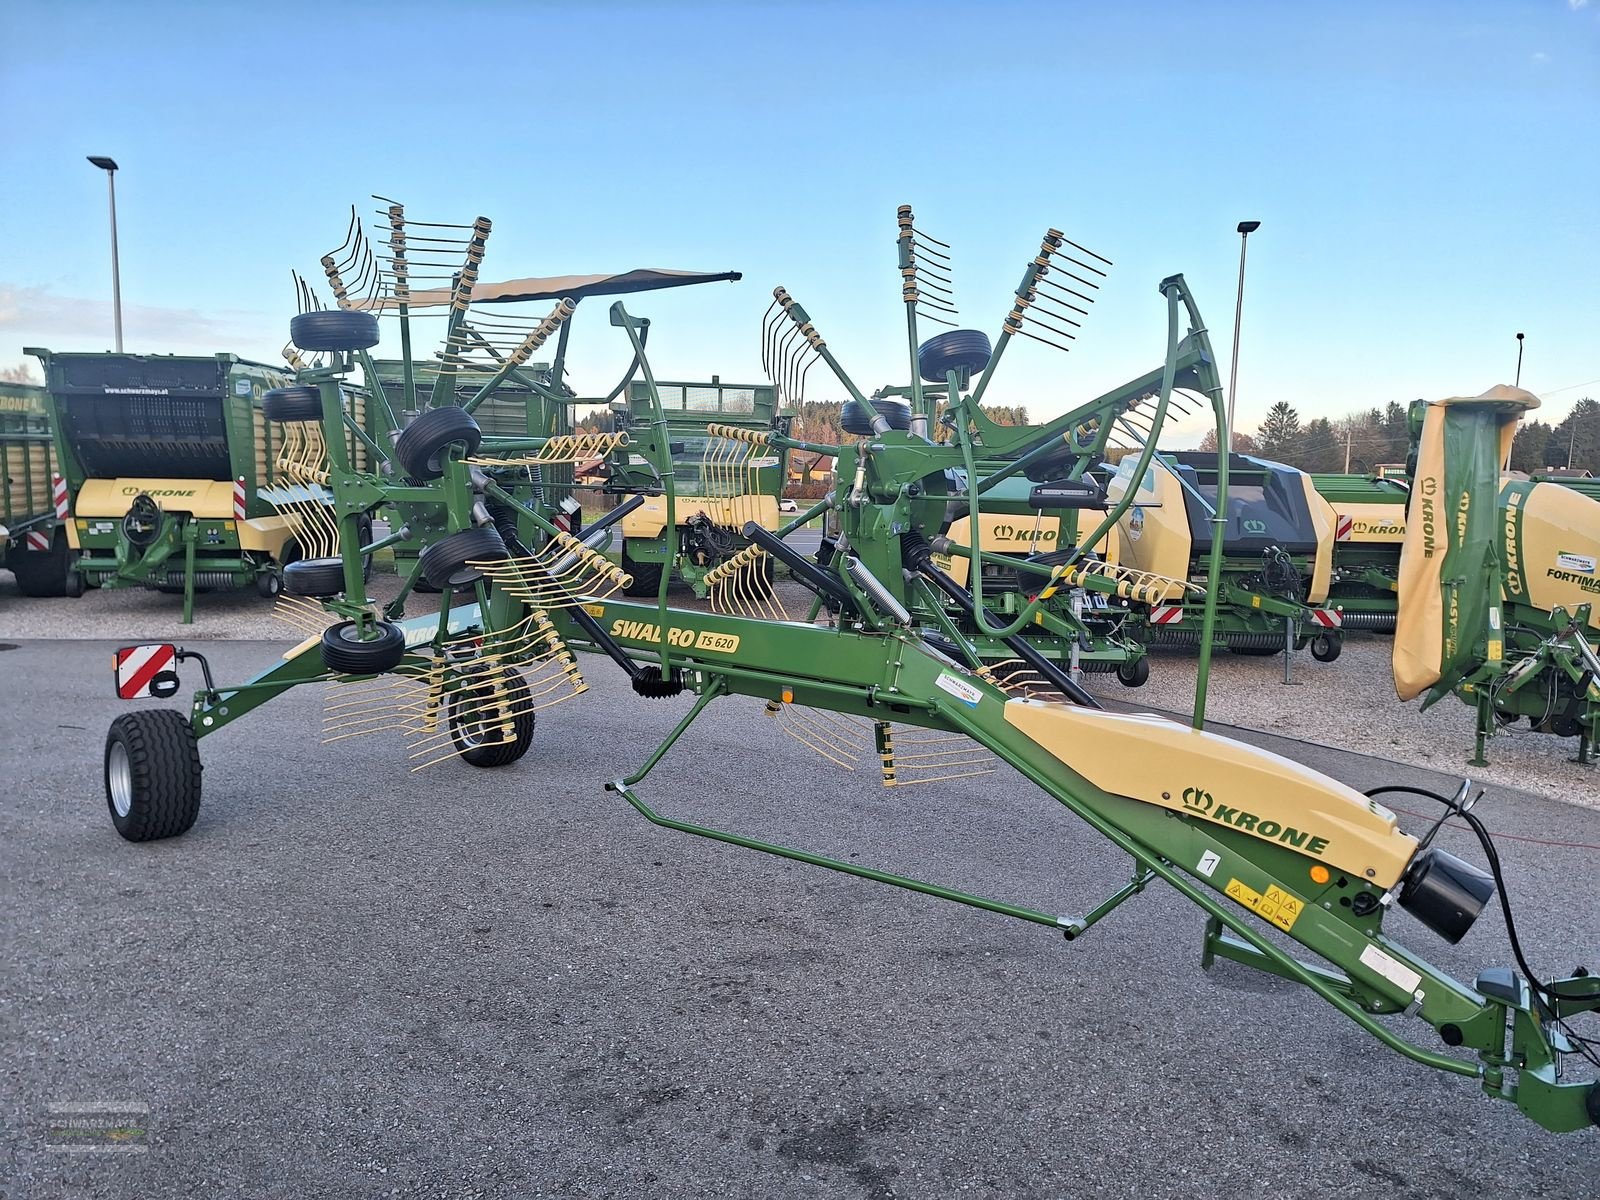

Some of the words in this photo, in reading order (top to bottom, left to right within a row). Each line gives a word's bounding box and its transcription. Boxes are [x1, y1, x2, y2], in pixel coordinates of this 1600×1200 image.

[0, 396, 29, 411] RONE
[1015, 530, 1084, 542] KROE
[1368, 525, 1406, 535] KRON
[1421, 498, 1436, 558] KRONE
[1506, 492, 1522, 574] KRONE
[405, 621, 460, 646] KROE
[701, 635, 714, 646] TS
[714, 638, 735, 649] 620
[1211, 803, 1331, 856] KRONE
